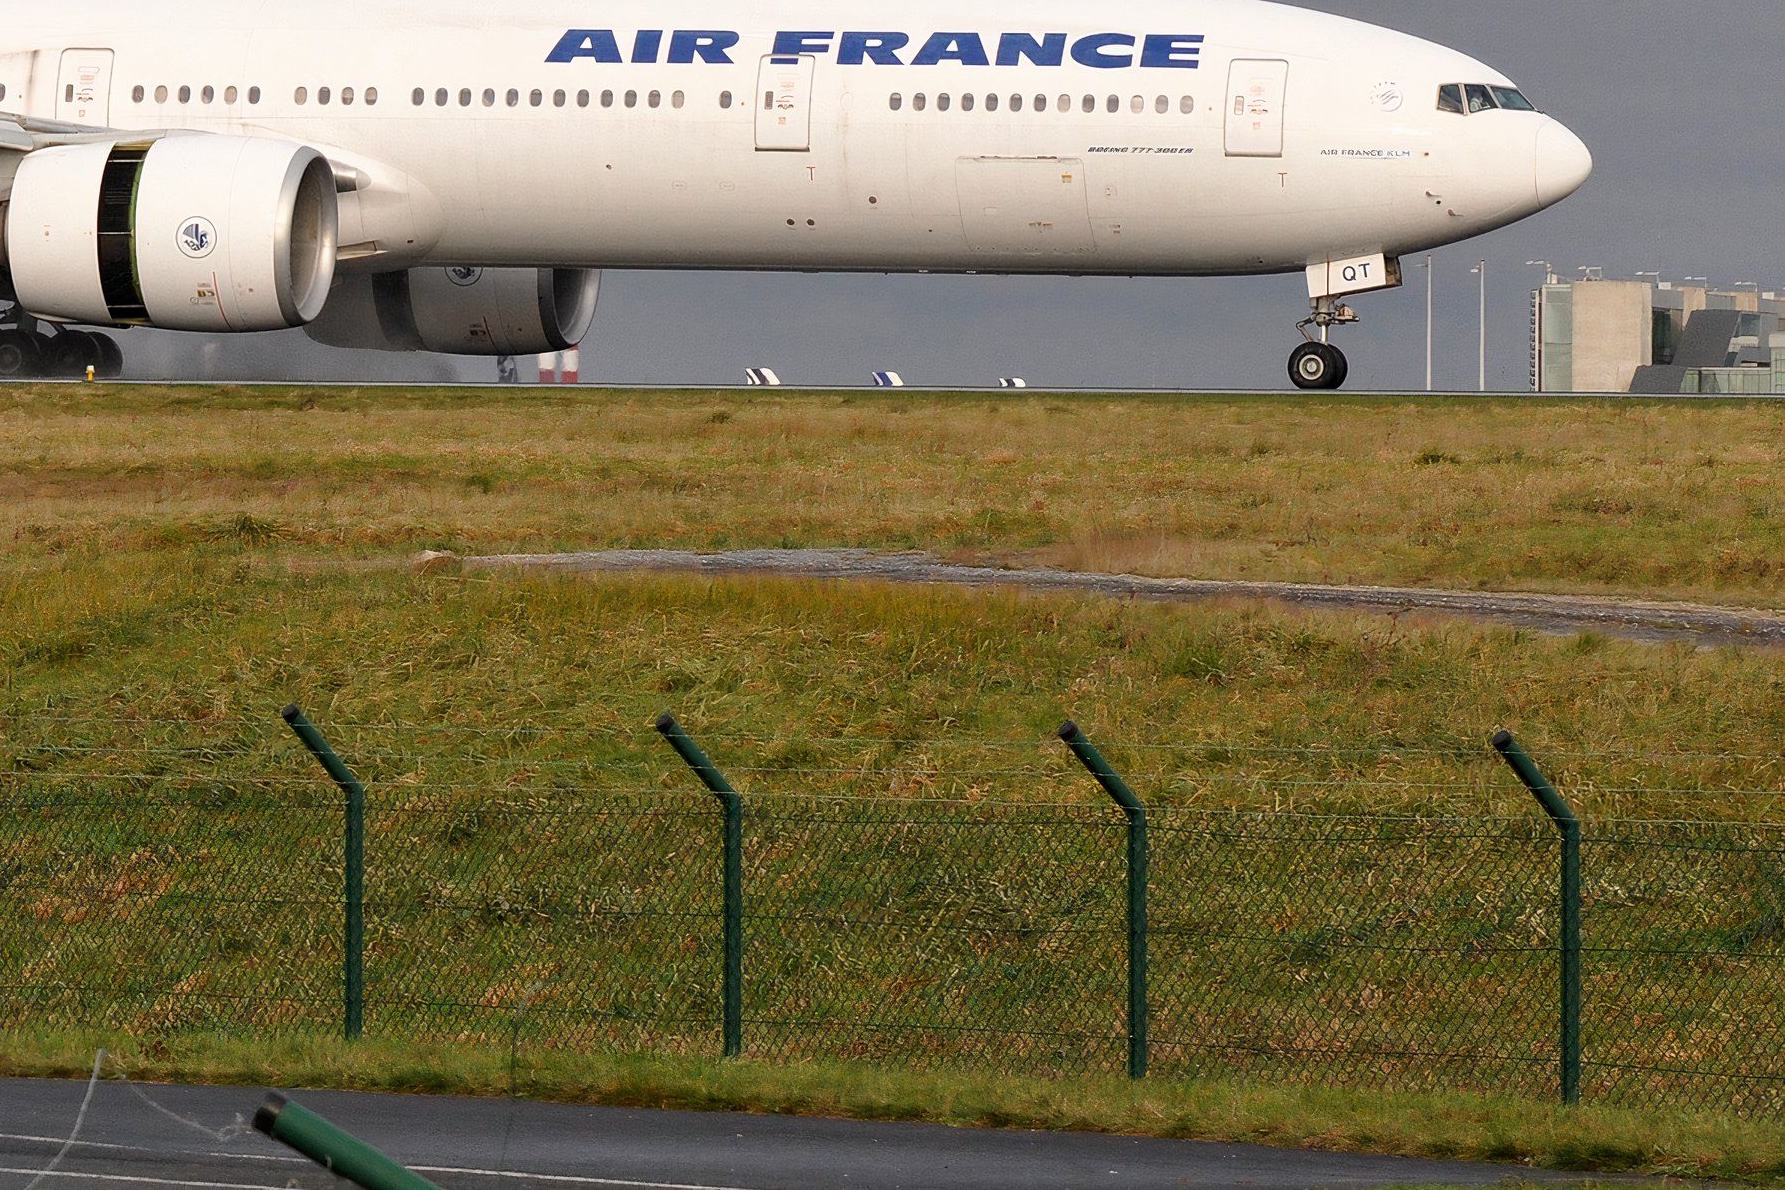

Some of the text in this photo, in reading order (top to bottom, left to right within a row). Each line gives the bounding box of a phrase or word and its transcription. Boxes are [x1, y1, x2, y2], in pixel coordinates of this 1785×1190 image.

[544, 29, 1205, 69] AIR FRANCE
[1341, 149, 1384, 157] FRANCE
[1342, 262, 1370, 282] QT
